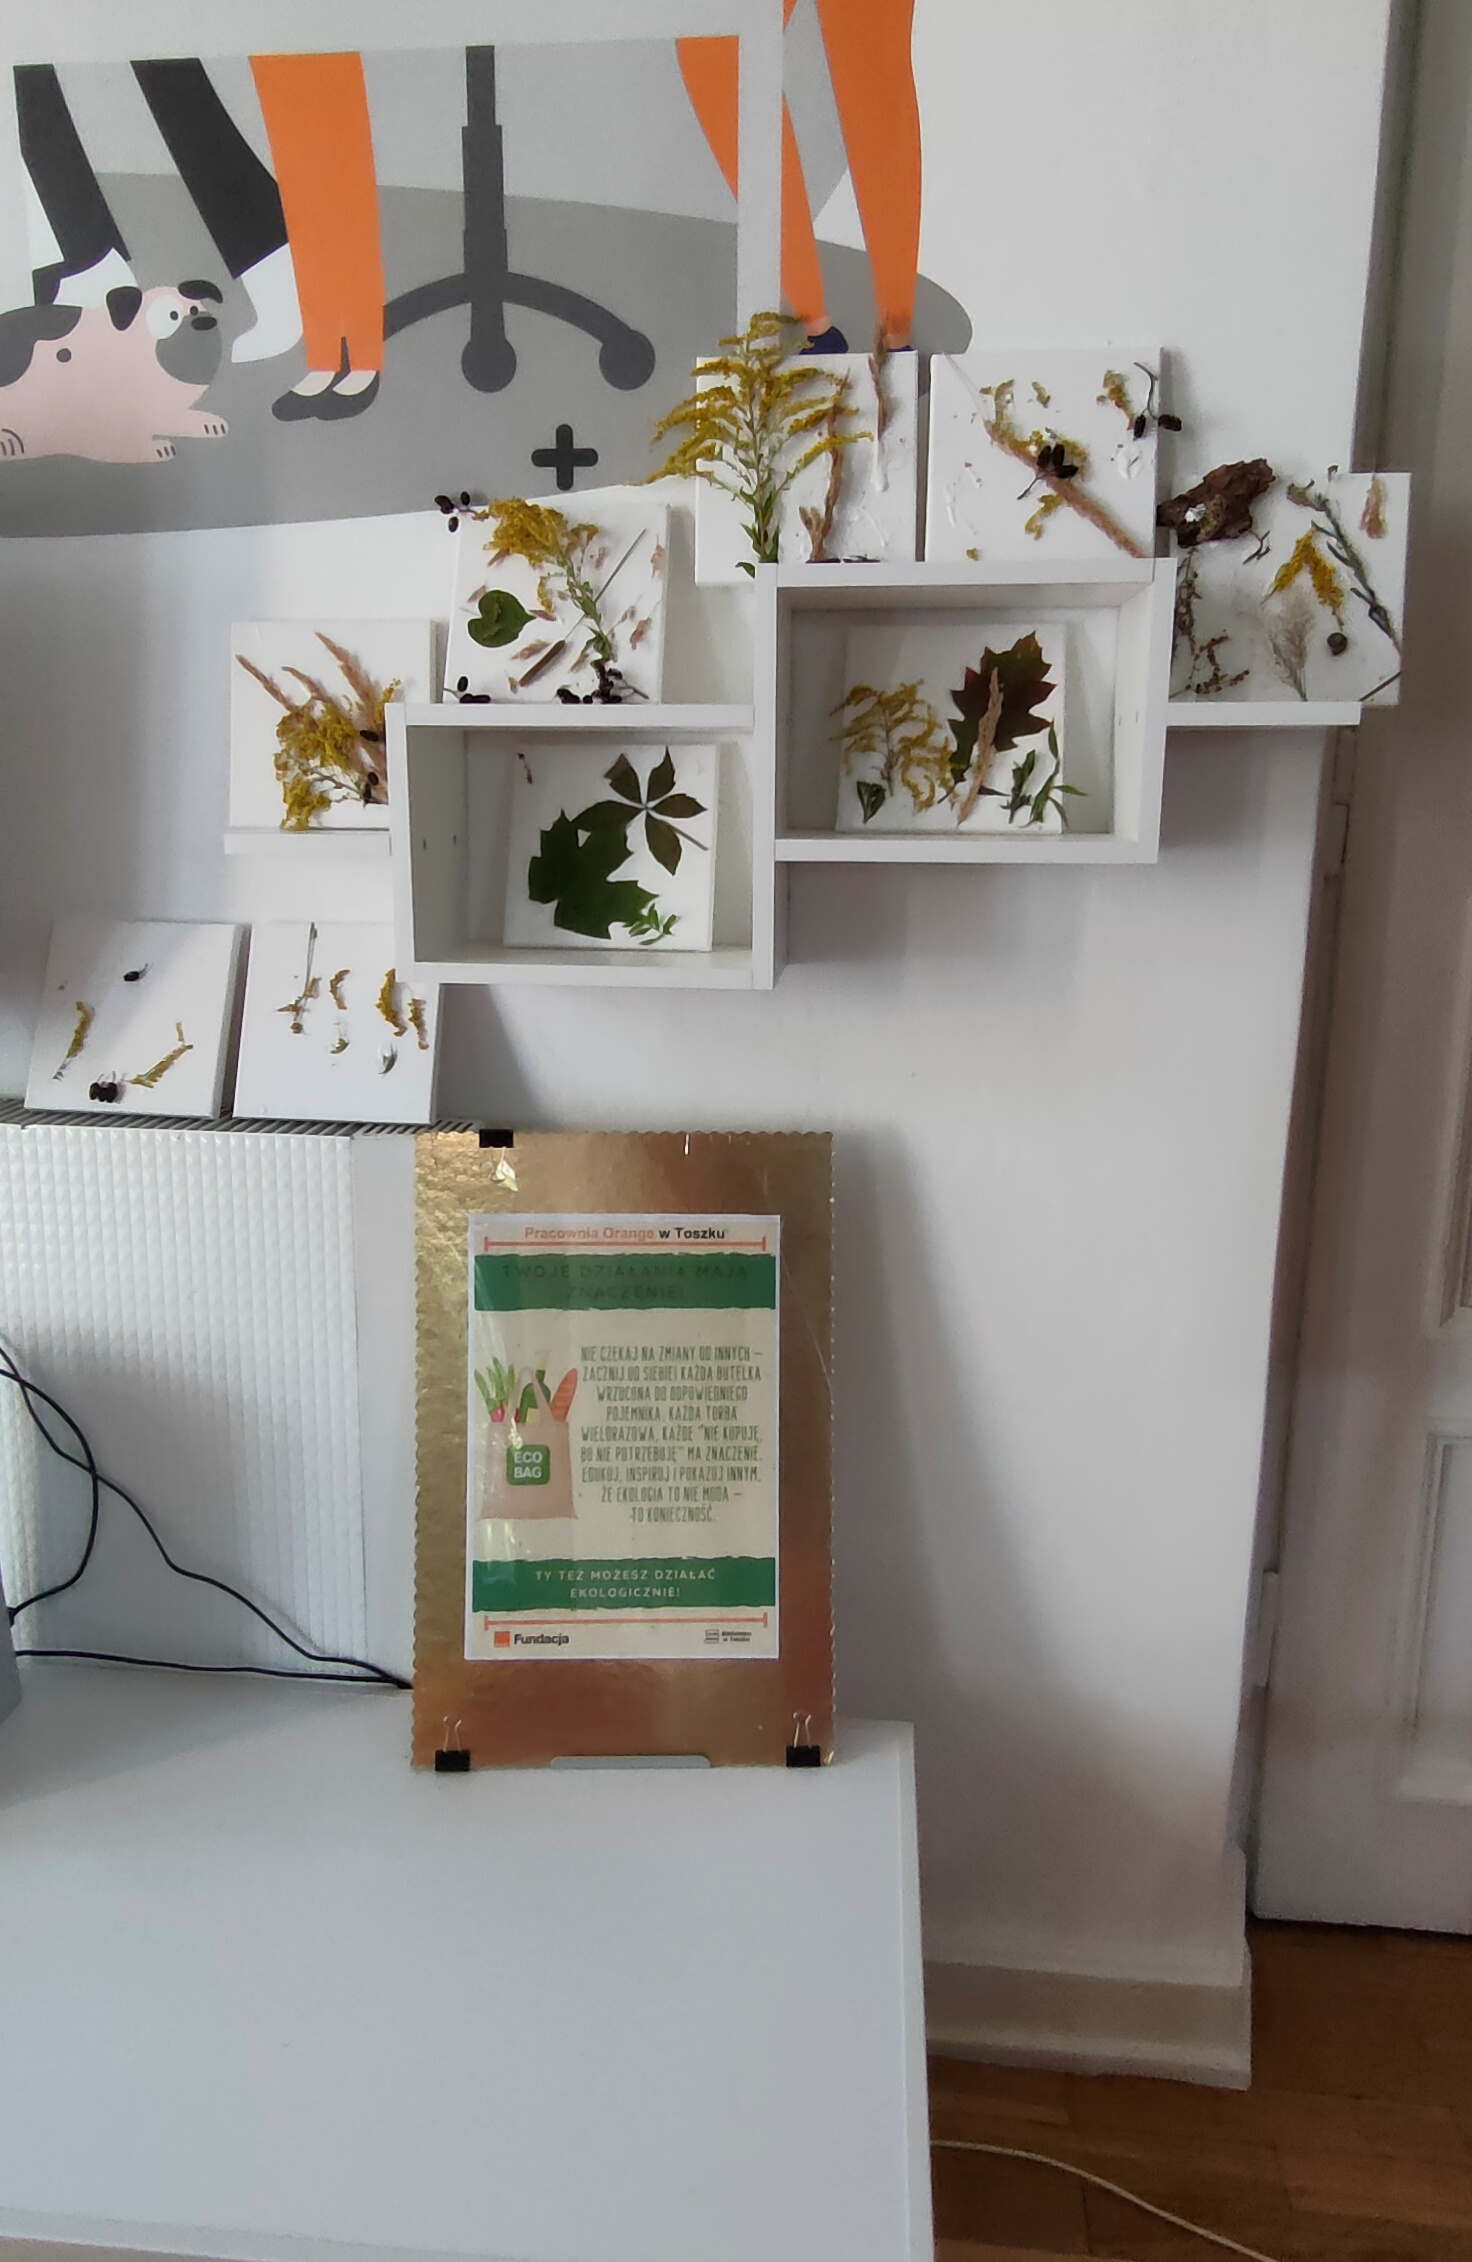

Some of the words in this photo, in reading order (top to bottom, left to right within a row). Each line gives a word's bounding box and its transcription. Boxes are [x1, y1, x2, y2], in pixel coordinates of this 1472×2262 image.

[524, 1227, 598, 1240] Pracownia
[603, 1227, 654, 1242] Orange
[659, 1230, 670, 1239] w
[675, 1227, 726, 1240] Toszku
[502, 1264, 570, 1278] TWOJE
[580, 1264, 686, 1278] DZIAŁANIA
[581, 1346, 596, 1361] NIE
[600, 1346, 638, 1361] CZEKAJ
[641, 1346, 655, 1361] NA
[659, 1346, 696, 1361] ZMIANY
[700, 1346, 711, 1361] OD
[715, 1346, 750, 1361] INNYCH
[582, 1366, 625, 1382] ZACZNIJ
[627, 1366, 640, 1381] OD
[680, 1364, 713, 1381] KAŻDA
[716, 1365, 761, 1381] BUTELKA
[597, 1385, 650, 1401] WRZUCONA
[654, 1385, 666, 1401] DO
[670, 1385, 747, 1401] ODPOWIEDNIEGO
[706, 1405, 737, 1421] TORBA
[514, 1451, 543, 1464] ECO
[580, 1446, 593, 1462] BO
[596, 1446, 611, 1462] NIE
[687, 1446, 701, 1461] MA
[514, 1466, 542, 1479] BAG
[626, 1466, 670, 1482] INSPIRUJ
[679, 1466, 723, 1481] POKAZUJ
[617, 1486, 663, 1502] EKOLOGIA
[668, 1486, 680, 1502] TO
[684, 1486, 698, 1502] NIE
[702, 1486, 729, 1501] MODA
[632, 1506, 644, 1522] TO
[536, 1570, 551, 1580] TY
[655, 1567, 715, 1580] DZIAŁAĆ
[570, 1586, 680, 1598] EKOLOGICZNIE!
[514, 1632, 569, 1646] Fundacja
